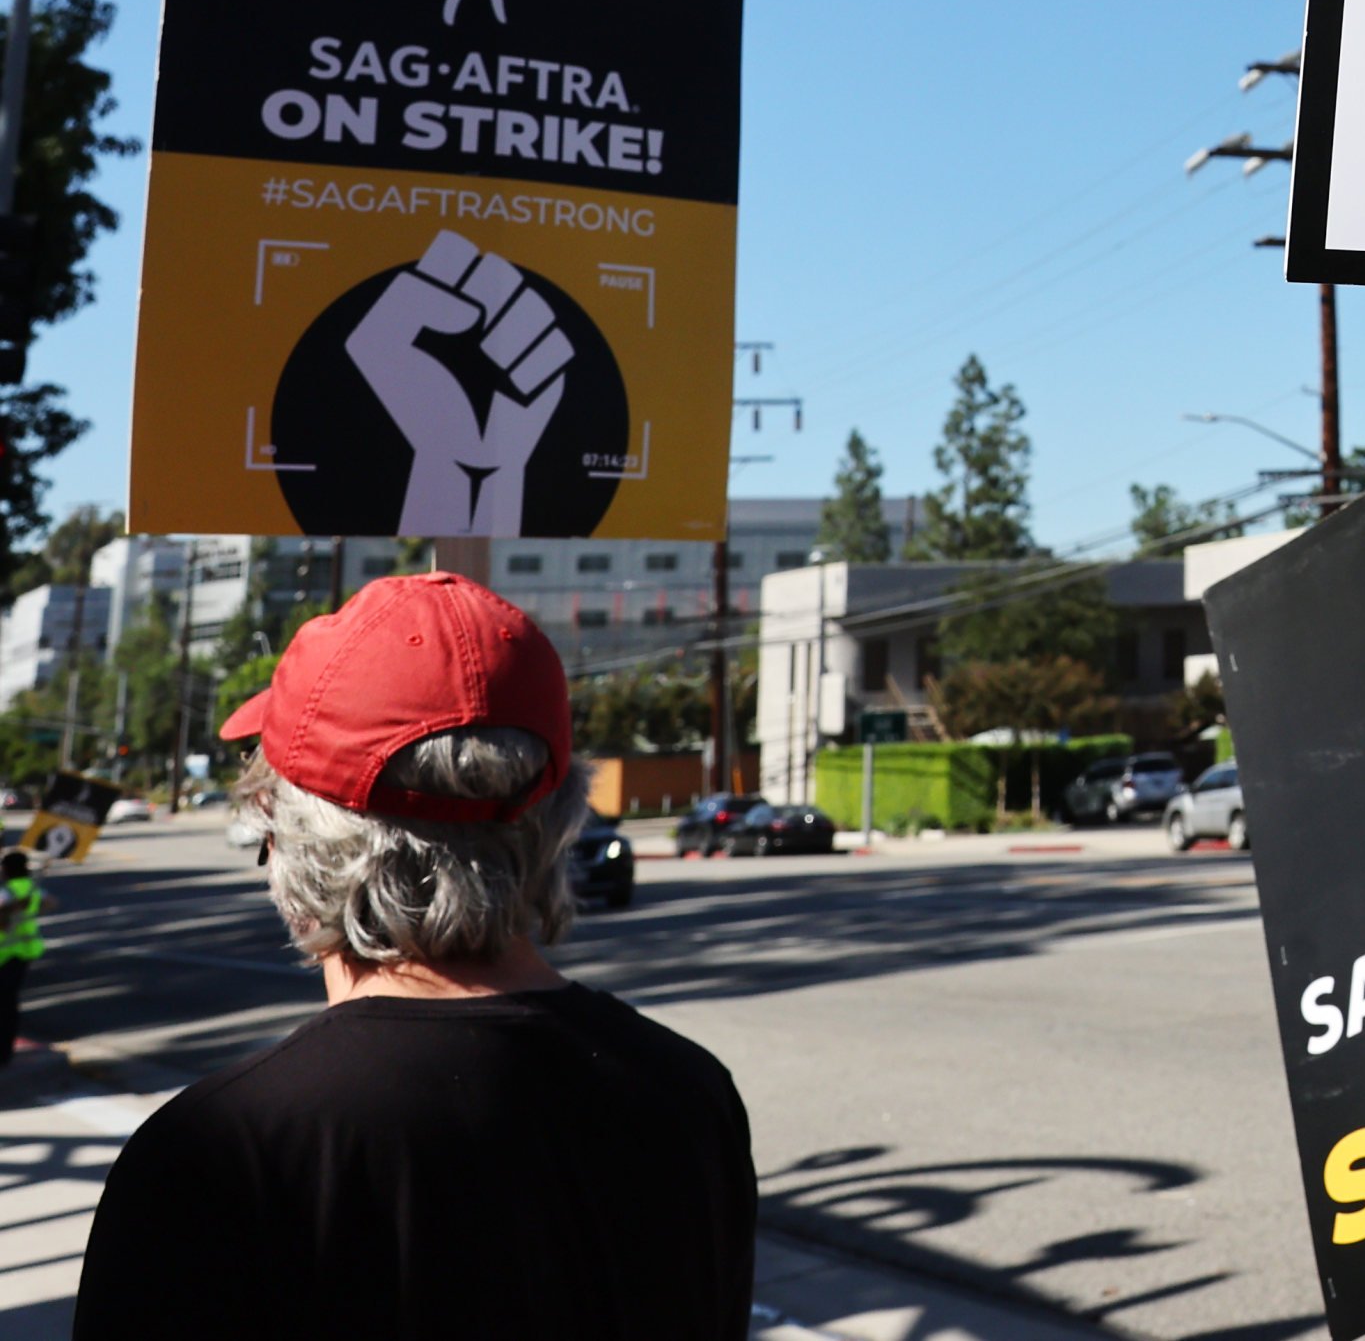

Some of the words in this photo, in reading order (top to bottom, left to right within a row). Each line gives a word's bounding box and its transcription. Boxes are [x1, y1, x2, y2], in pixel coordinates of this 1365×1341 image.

[261, 89, 378, 145] ON
[401, 101, 664, 175] STRIKE!
[261, 177, 655, 237] #SAGAFTRASTRONG
[600, 274, 644, 291] PAUSE
